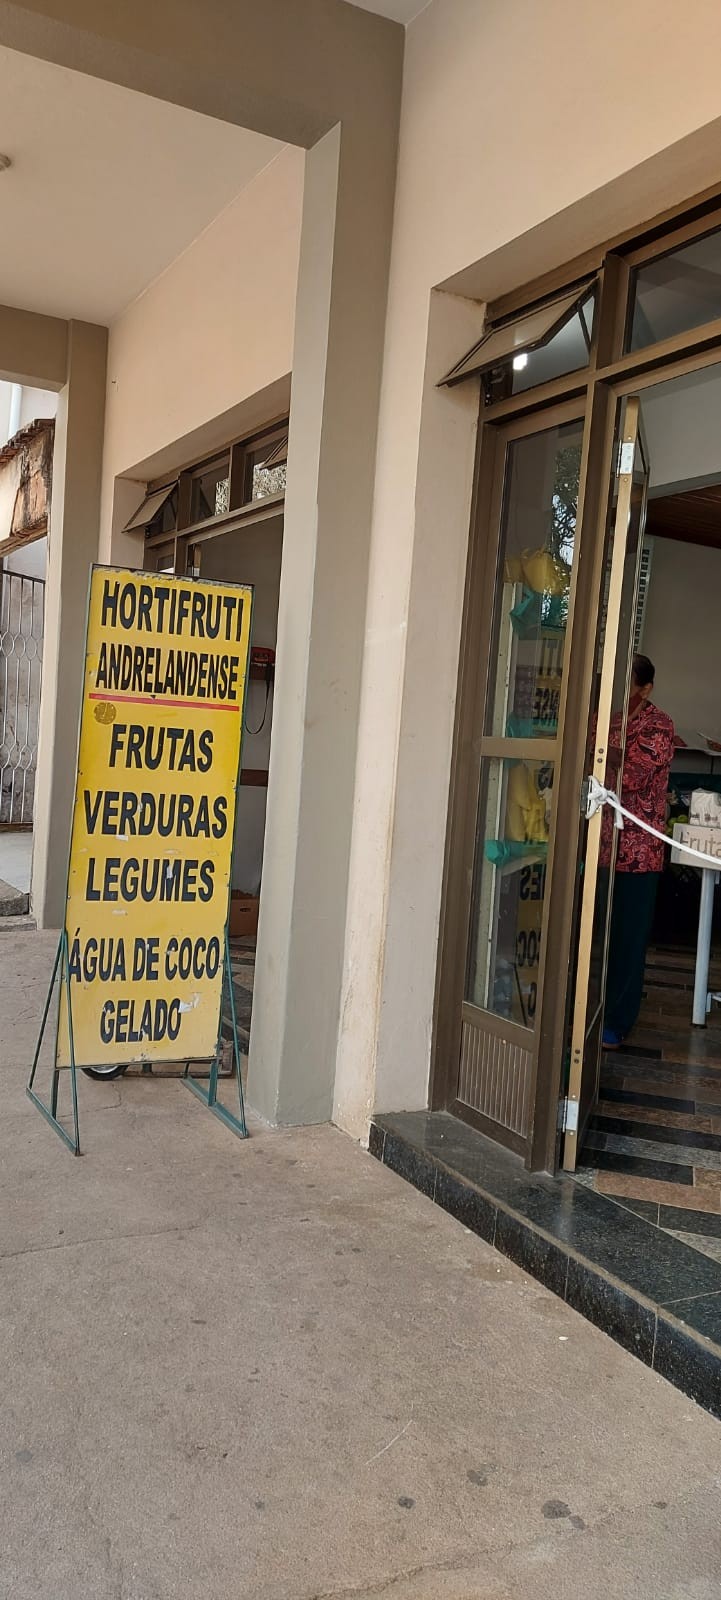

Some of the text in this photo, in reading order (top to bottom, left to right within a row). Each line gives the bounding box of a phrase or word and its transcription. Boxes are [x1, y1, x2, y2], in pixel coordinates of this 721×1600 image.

[101, 580, 244, 641] HORTIFRUTI
[95, 643, 239, 699] ANDRELANDENSE
[109, 724, 213, 772] FRUTAS
[84, 790, 227, 839] VERDURAS
[86, 858, 215, 902] LEGUMES
[69, 928, 219, 982] ÁGUA DE COCO
[100, 998, 181, 1043] GELADO
